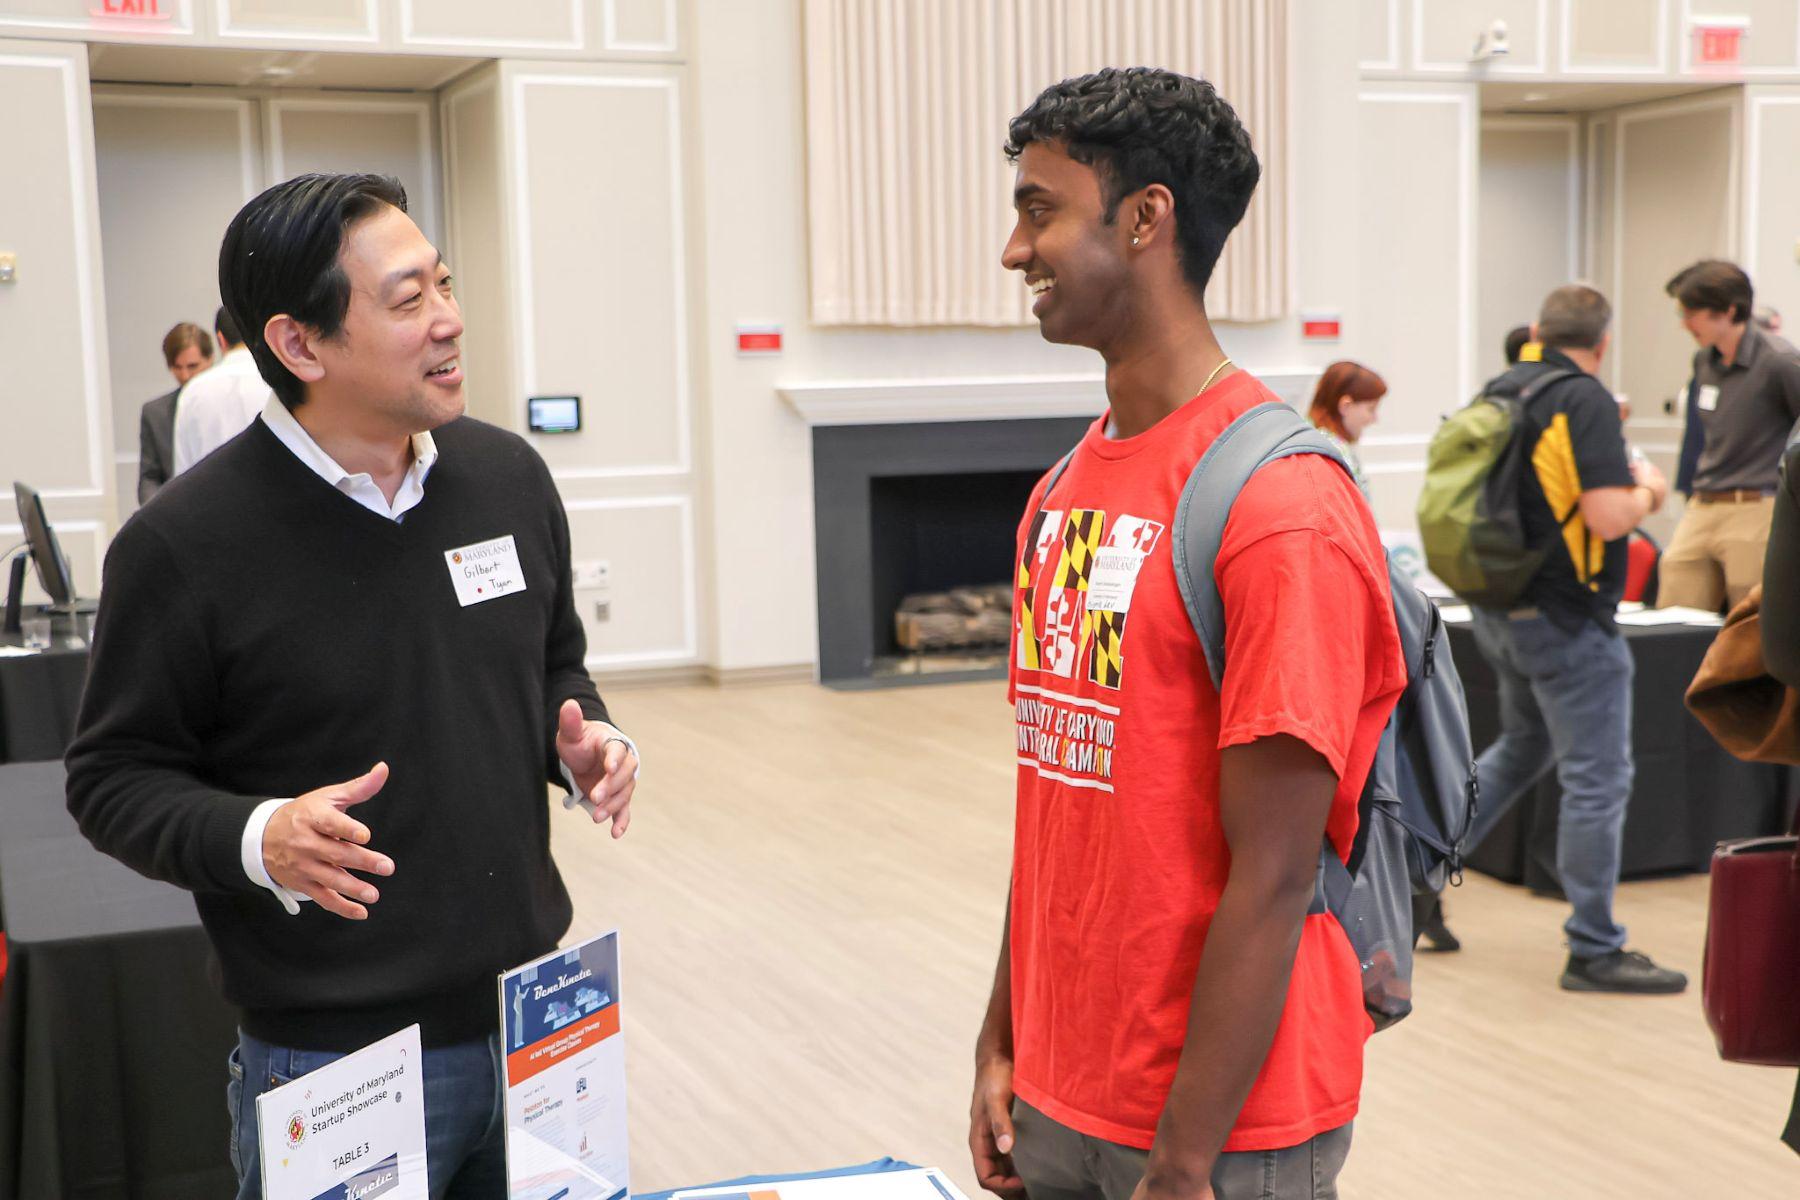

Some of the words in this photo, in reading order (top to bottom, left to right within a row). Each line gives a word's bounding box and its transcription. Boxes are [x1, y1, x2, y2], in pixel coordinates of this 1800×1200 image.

[463, 561, 502, 578] Gilbert
[311, 1089, 354, 1118] University
[357, 1084, 366, 1096] of
[367, 1065, 404, 1090] Maryland
[312, 1112, 345, 1134] Startup
[347, 1089, 388, 1117] Showcase
[332, 1146, 362, 1170] TABLE
[364, 1142, 370, 1154] 3
